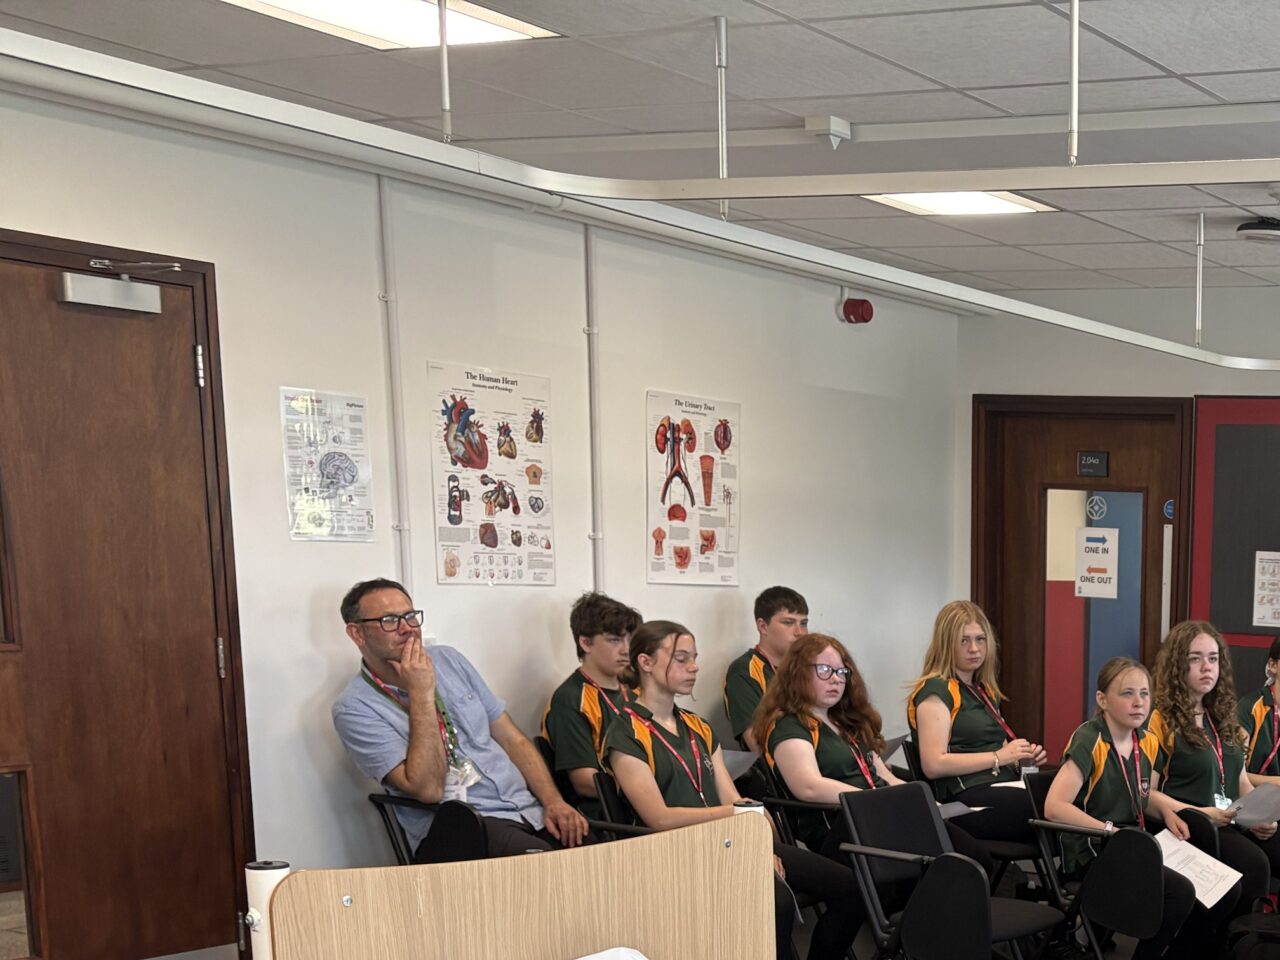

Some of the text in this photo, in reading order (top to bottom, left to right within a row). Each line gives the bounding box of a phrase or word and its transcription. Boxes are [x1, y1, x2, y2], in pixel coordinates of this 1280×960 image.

[464, 371, 518, 386] The Human Heart
[674, 399, 715, 411] The Urinary Tract
[1084, 546, 1110, 555] ONE IN
[1080, 575, 1113, 585] ONE OUT
